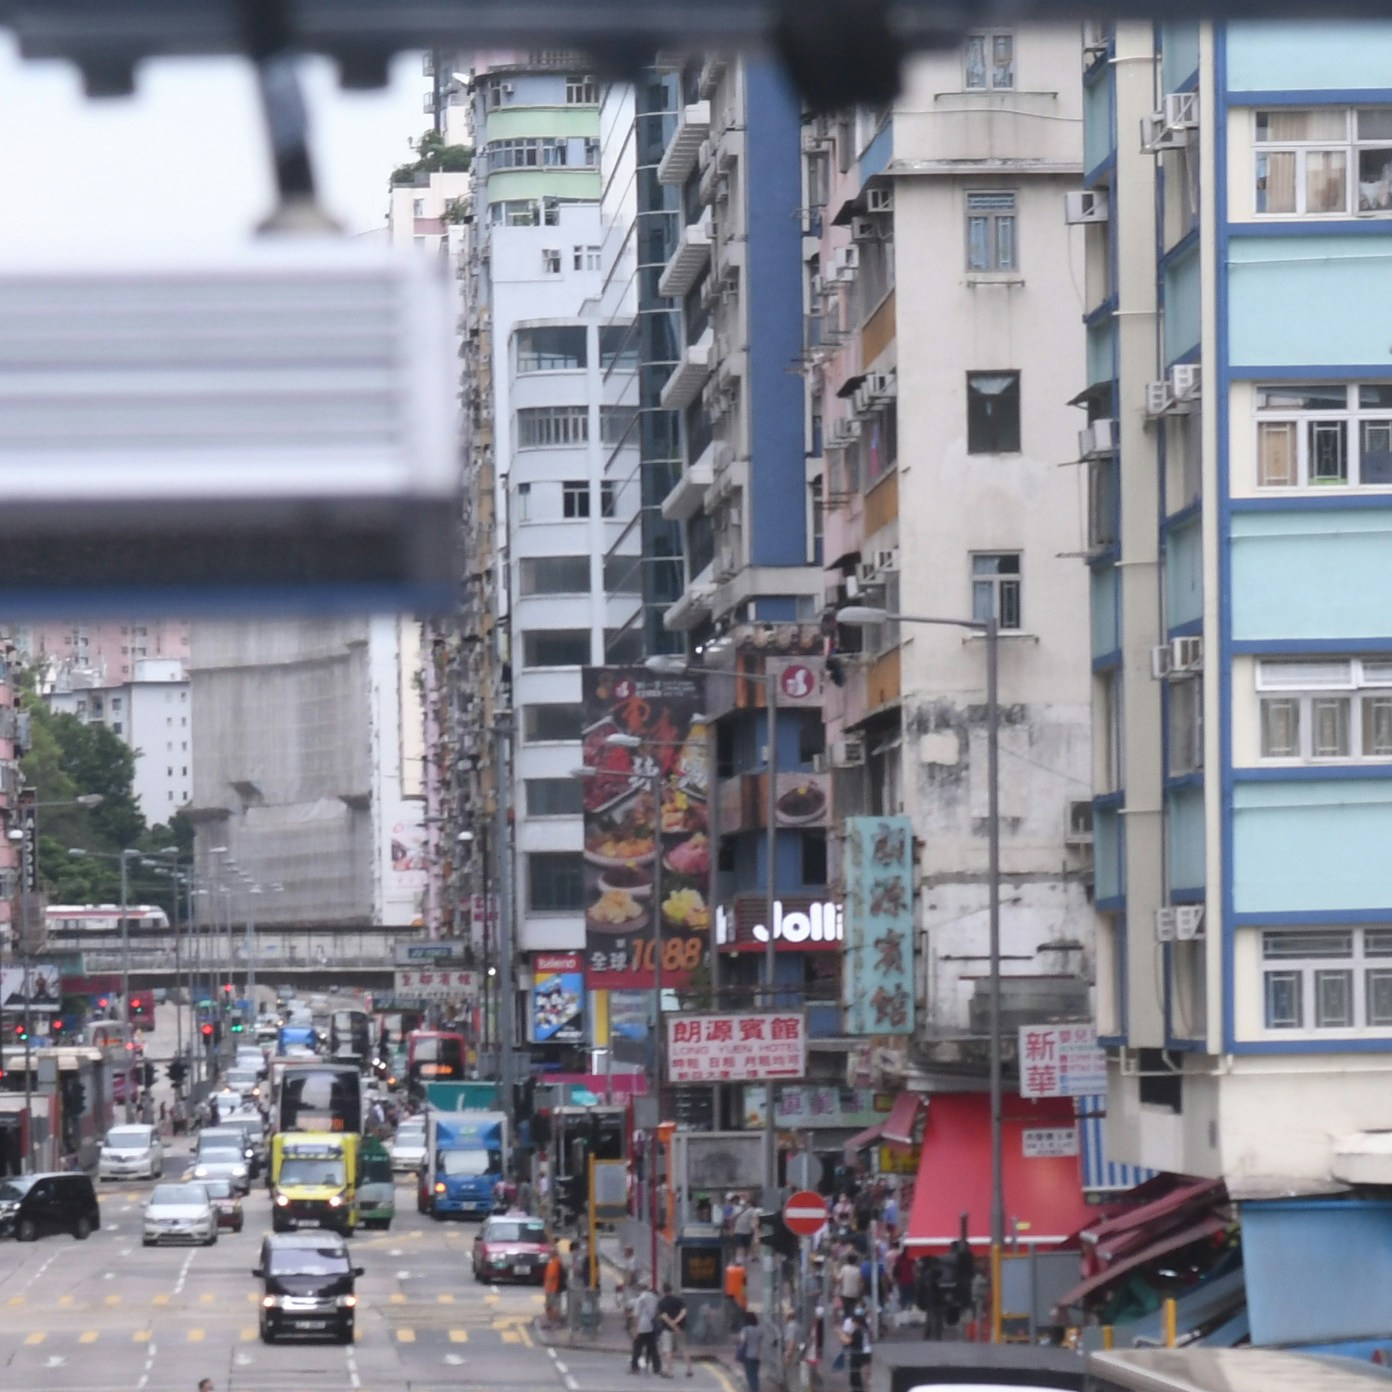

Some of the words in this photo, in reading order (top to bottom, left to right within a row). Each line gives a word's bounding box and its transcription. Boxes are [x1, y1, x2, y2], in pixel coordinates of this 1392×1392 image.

[673, 1017, 801, 1043] 朗源賓館
[1025, 1030, 1057, 1096] 新華
